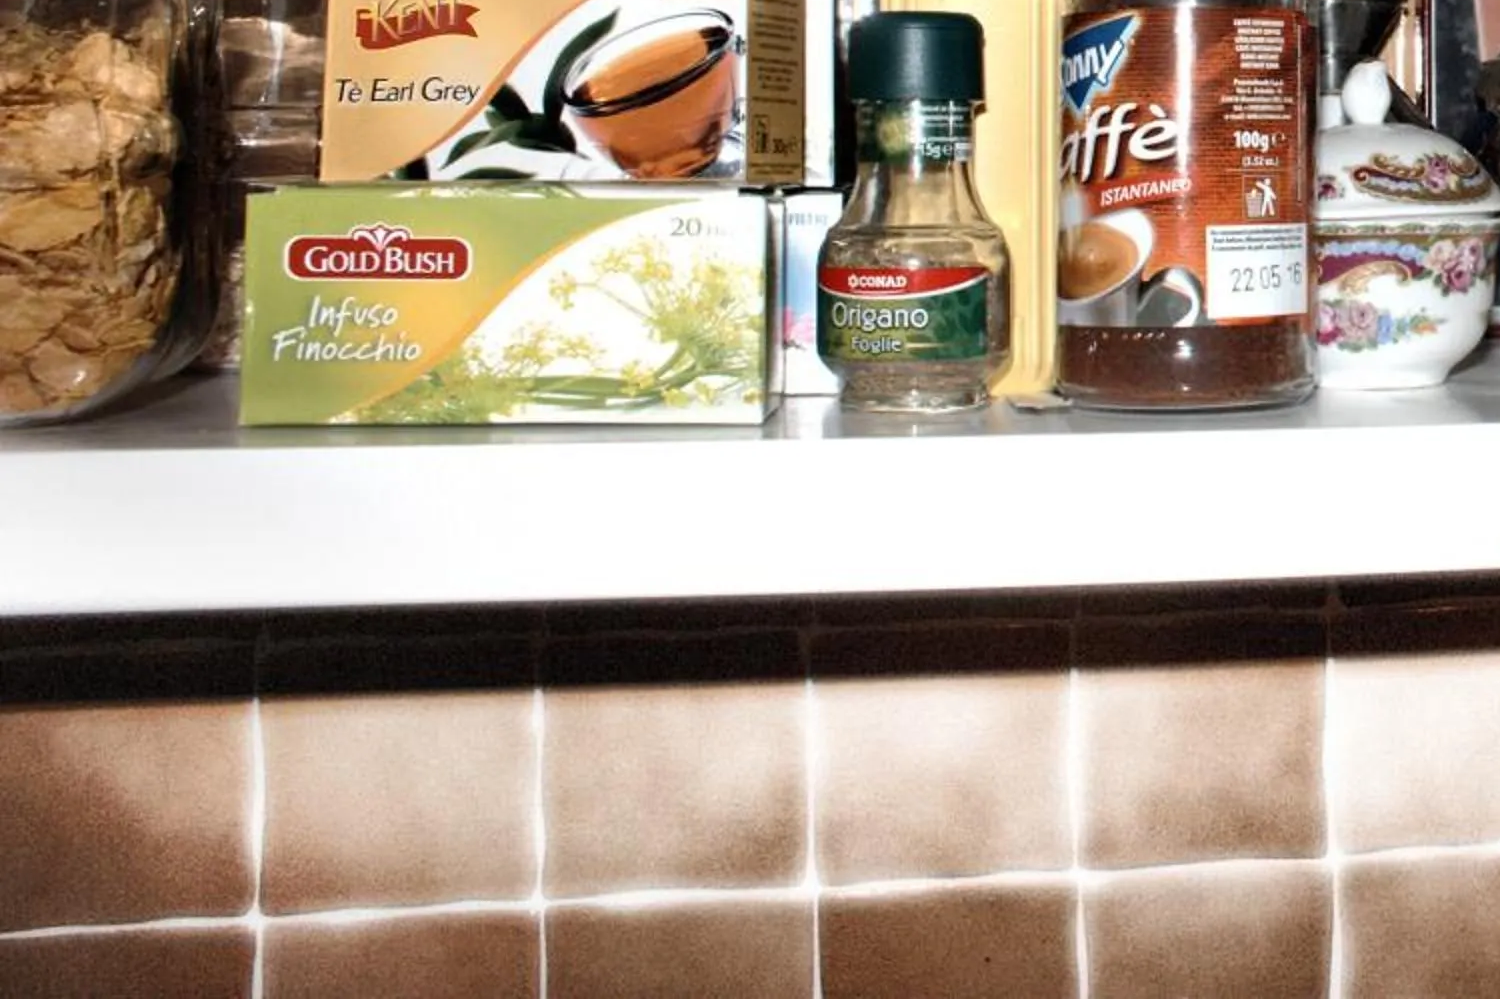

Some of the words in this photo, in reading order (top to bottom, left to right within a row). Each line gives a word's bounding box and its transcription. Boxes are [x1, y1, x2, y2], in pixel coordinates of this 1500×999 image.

[1064, 39, 1124, 85] onny
[335, 78, 362, 103] Tè
[371, 78, 414, 103] Earl
[421, 76, 480, 106] Grey
[1060, 101, 1182, 184] affè
[1232, 130, 1270, 153] 100g
[1100, 177, 1193, 207] ISTANTANEO
[669, 216, 702, 237] 20
[304, 245, 380, 273] GOLD
[384, 246, 455, 274] BUSH
[858, 275, 908, 288] CONAD
[1229, 267, 1254, 293] 22
[1259, 264, 1281, 290] 05
[308, 294, 399, 338] Infuso
[831, 301, 929, 332] Origano
[271, 326, 422, 362] Finocchio
[850, 336, 902, 353] Foglie
